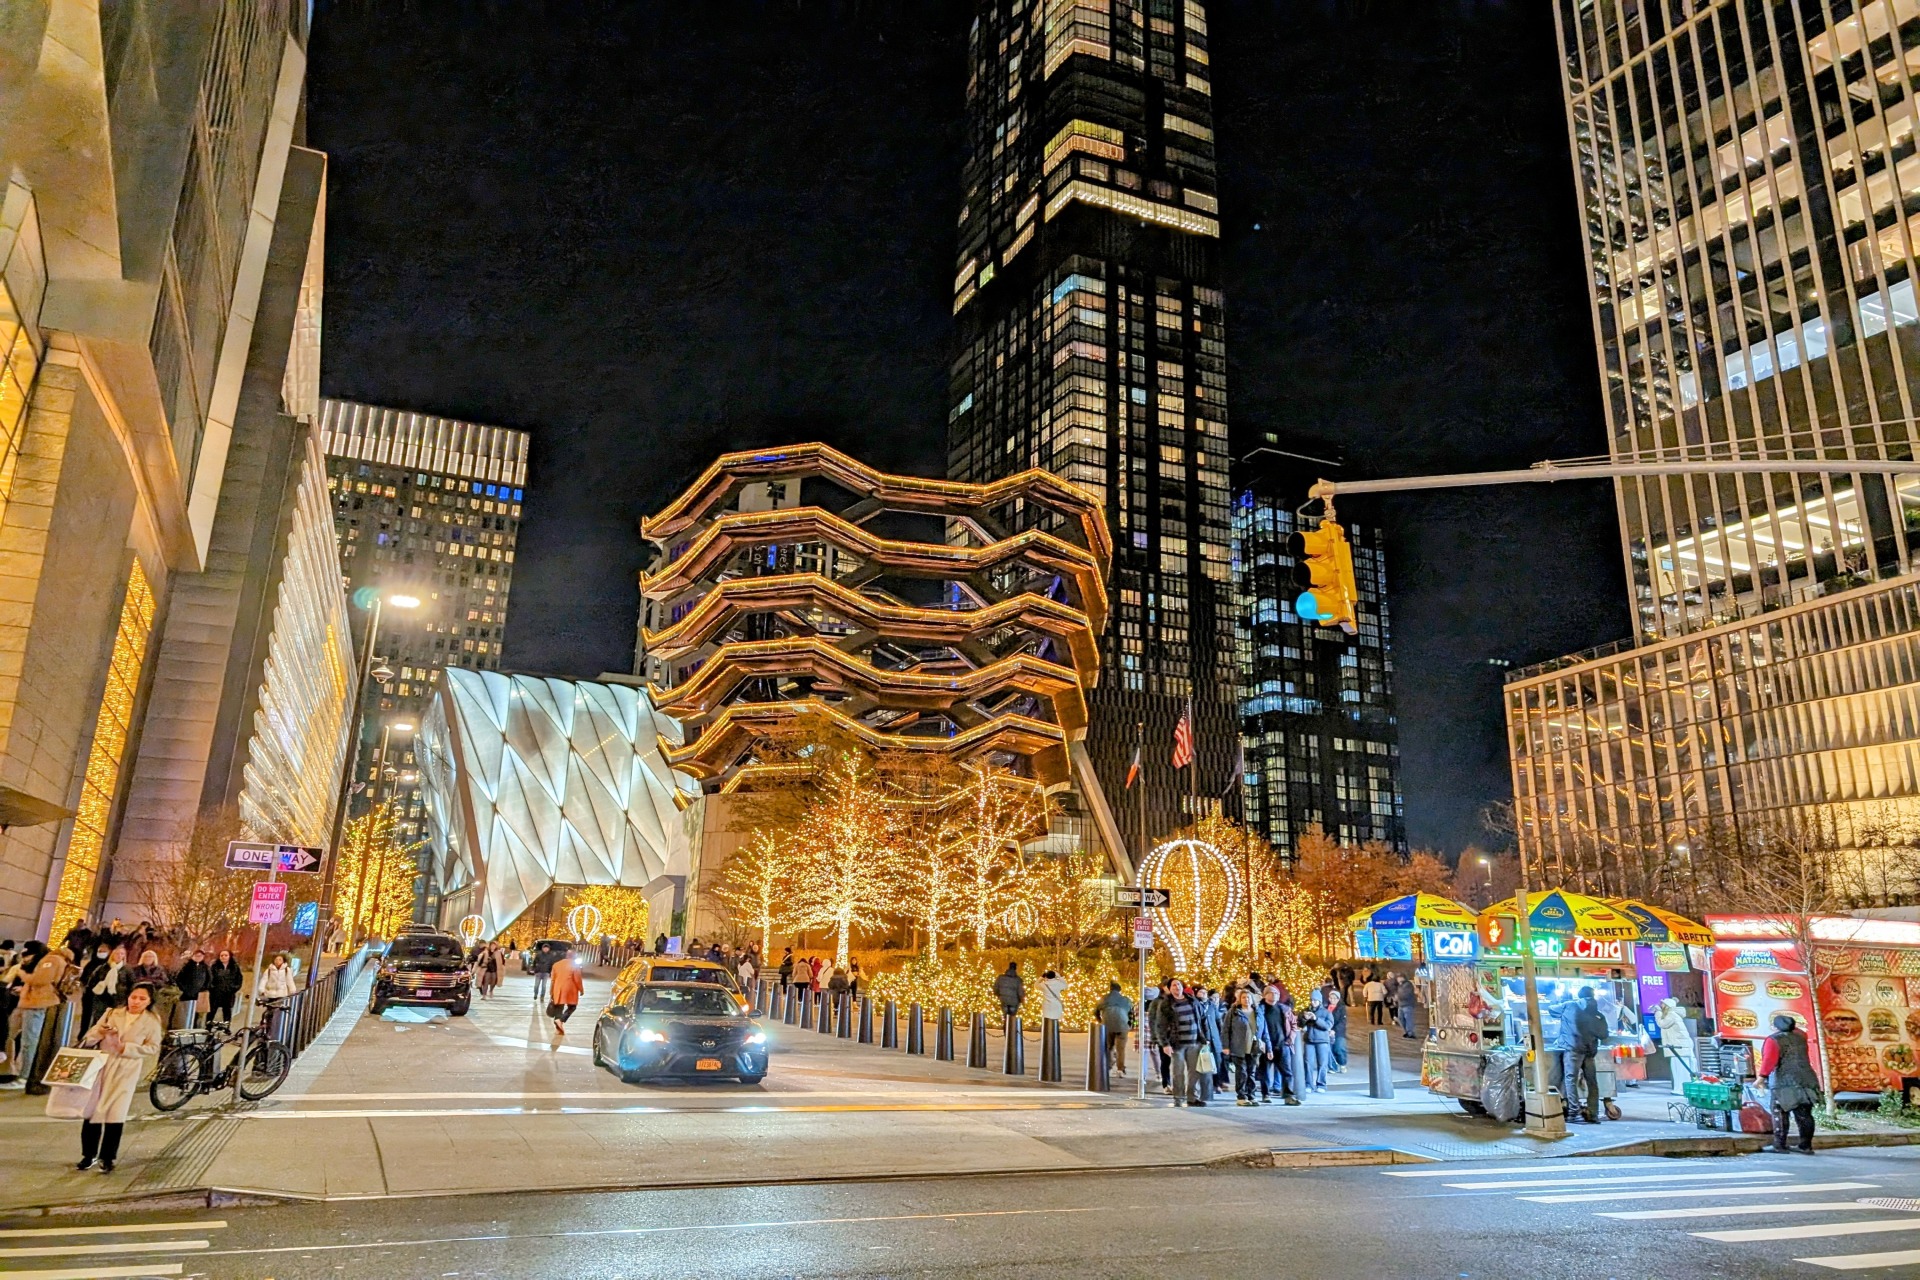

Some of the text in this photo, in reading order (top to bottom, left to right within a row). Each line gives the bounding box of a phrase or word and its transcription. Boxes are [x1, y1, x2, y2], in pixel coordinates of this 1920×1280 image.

[242, 850, 309, 865] ONE WAY
[1122, 892, 1161, 901] ONE WAY
[1419, 918, 1477, 931] SABRETT
[1583, 927, 1633, 937] SABRETT
[1677, 931, 1712, 943] ABRETT
[1740, 949, 1771, 958] Hebrew
[1735, 956, 1778, 966] NATIONAL
[1642, 975, 1664, 986] FREE
